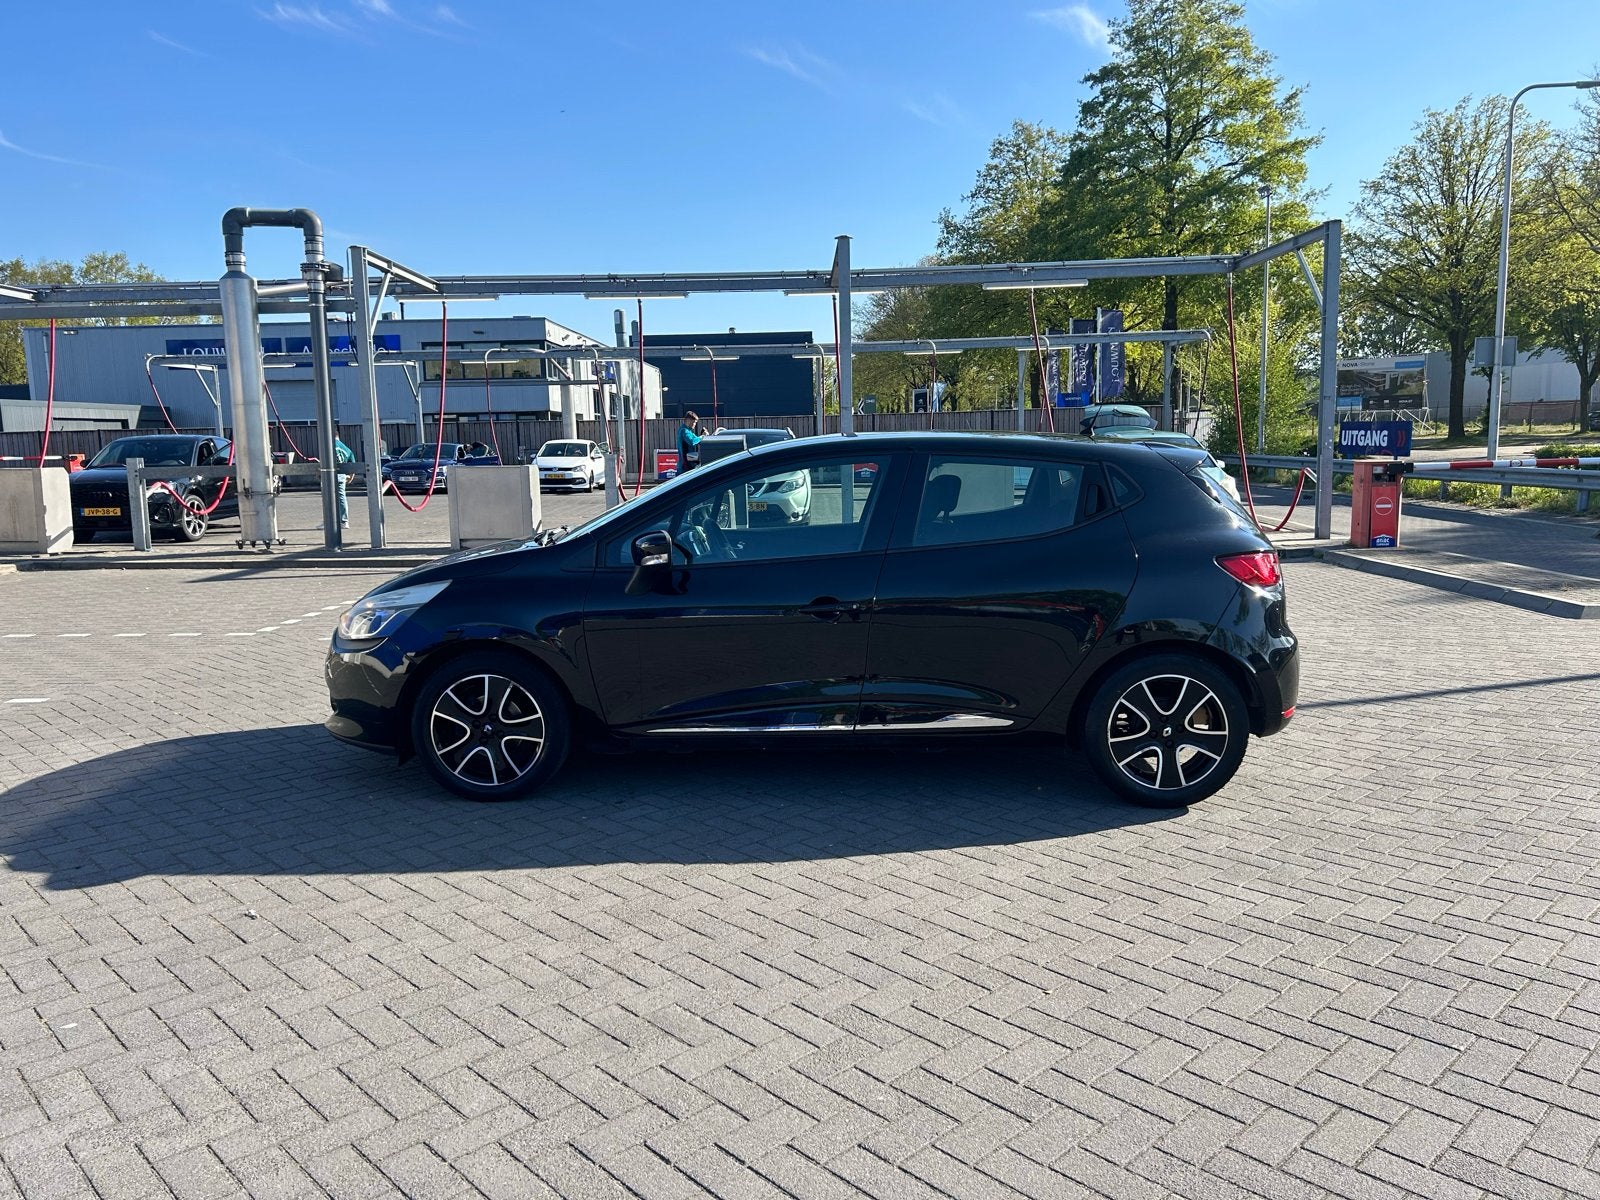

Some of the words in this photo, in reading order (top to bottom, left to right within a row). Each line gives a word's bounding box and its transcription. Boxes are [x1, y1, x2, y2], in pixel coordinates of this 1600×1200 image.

[1107, 326, 1120, 382] LOUWMN
[1341, 429, 1388, 447] UITGANG
[87, 508, 118, 516] JVP-38-G
